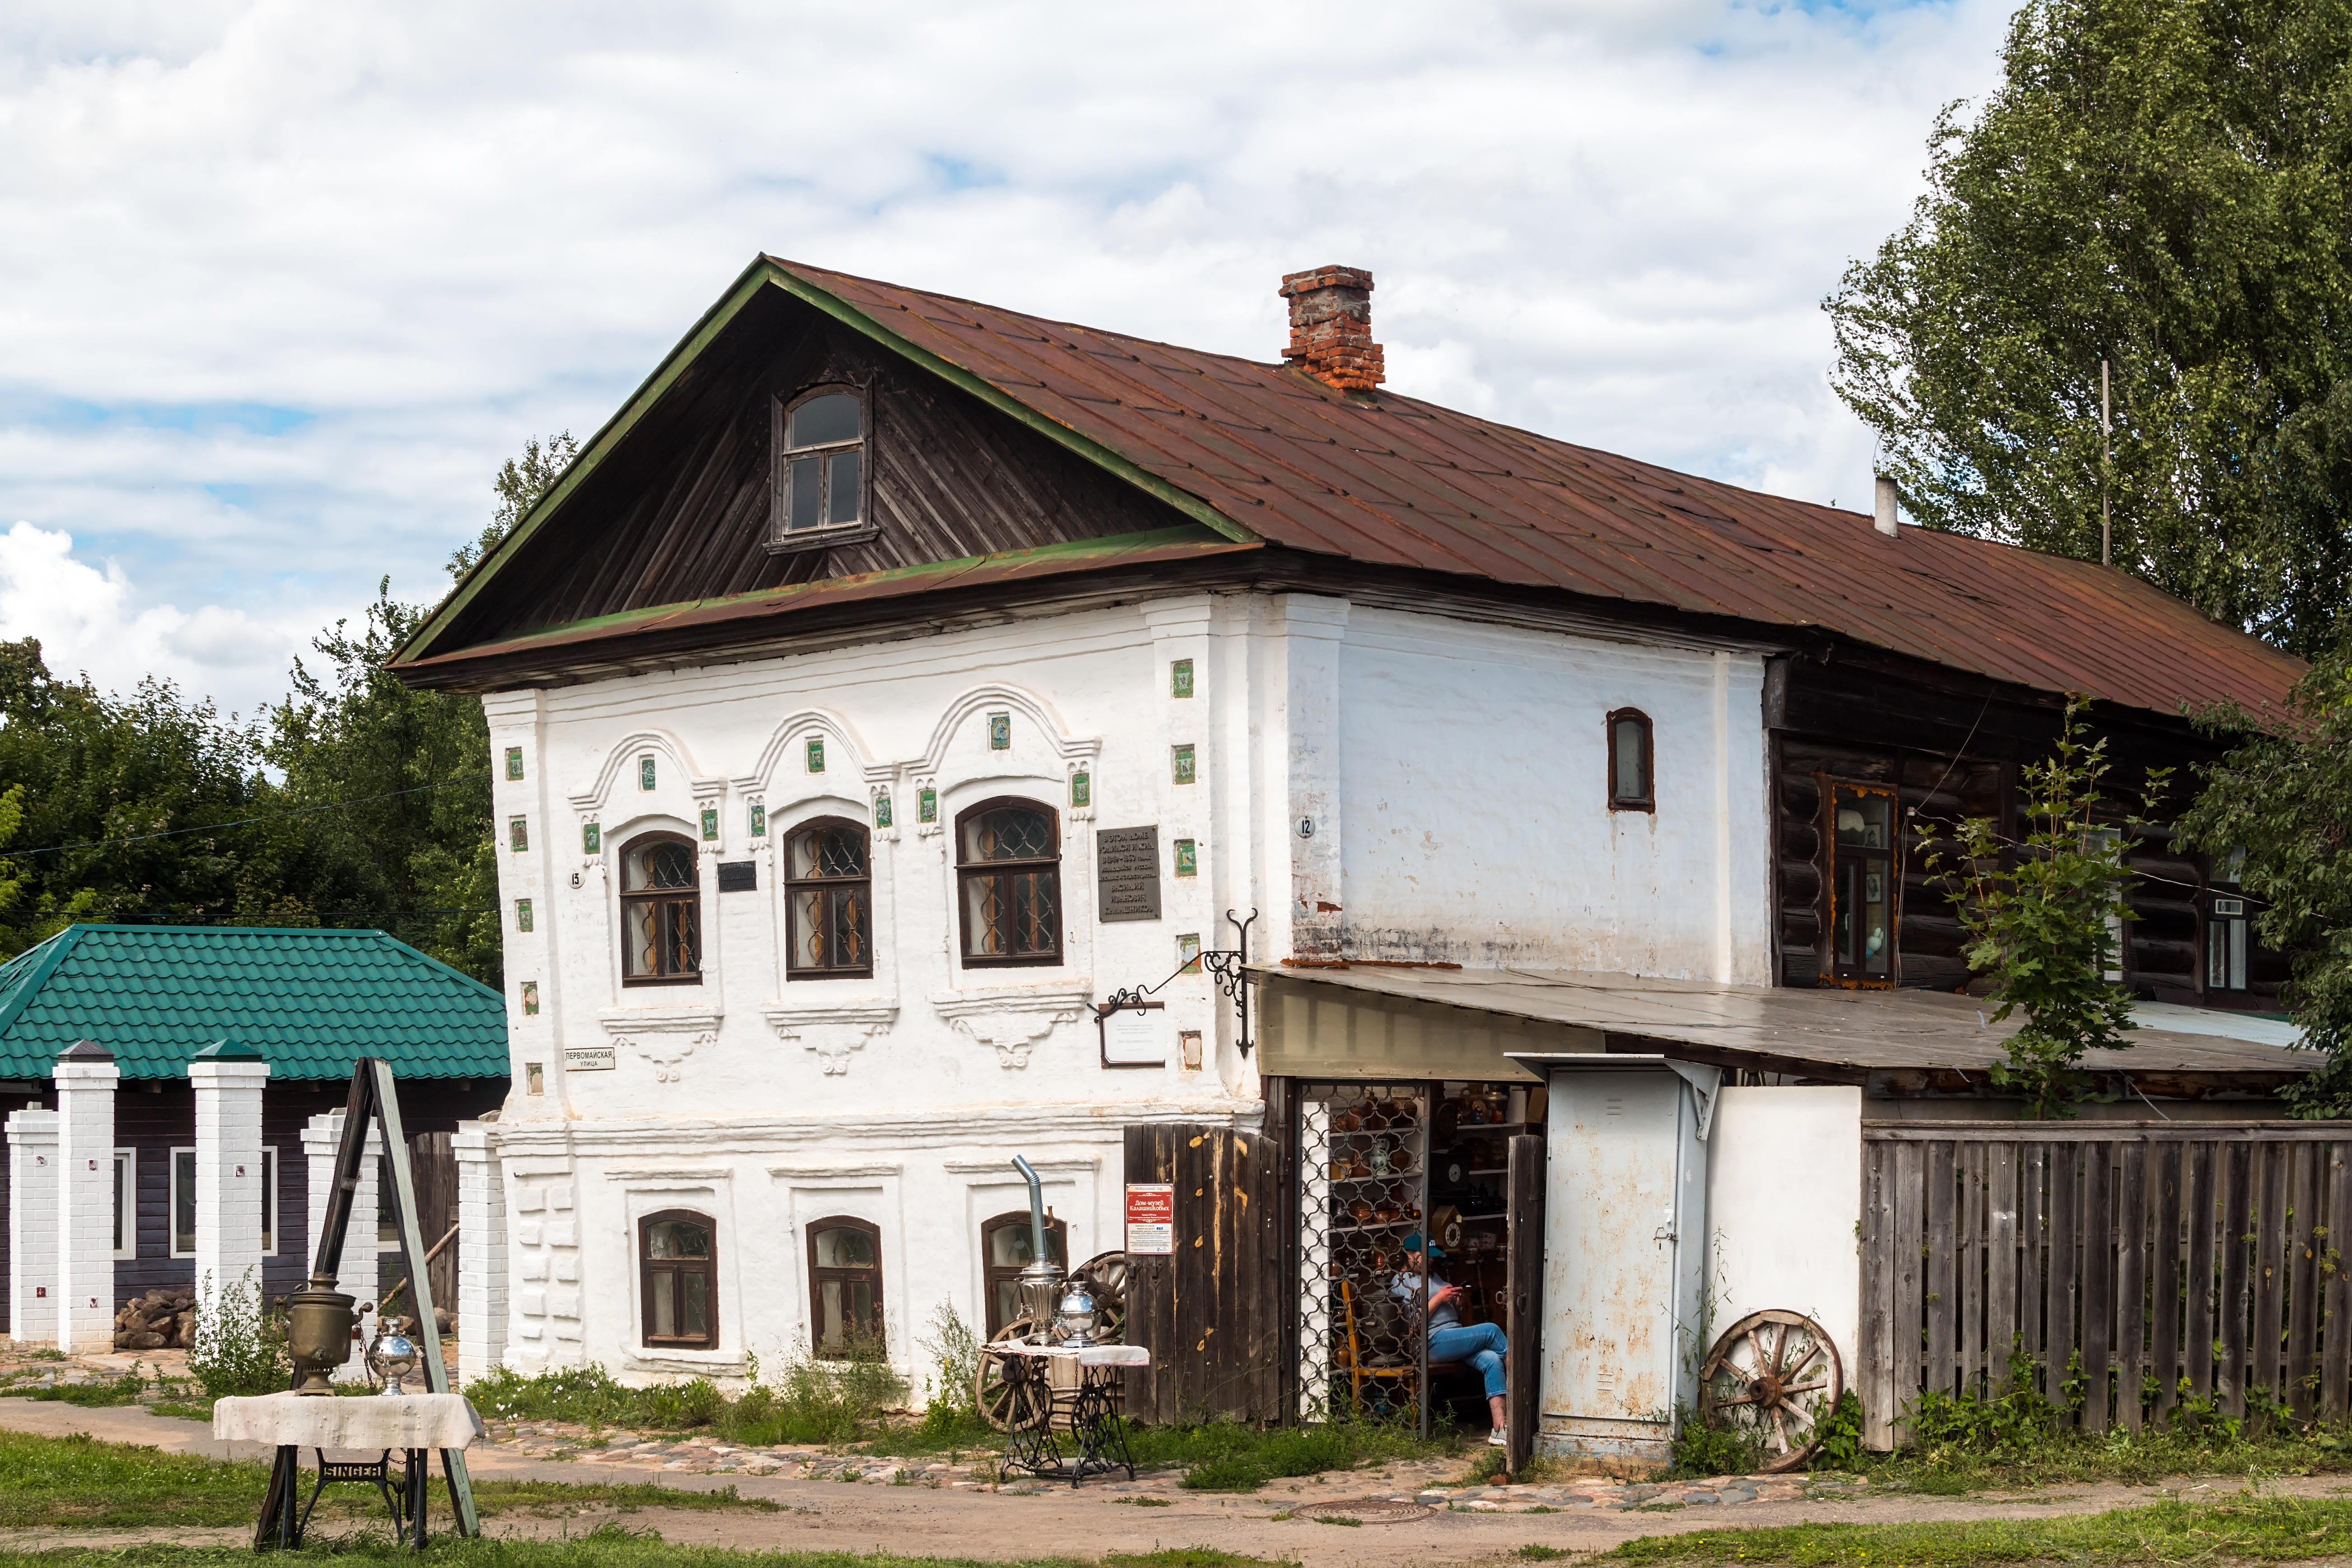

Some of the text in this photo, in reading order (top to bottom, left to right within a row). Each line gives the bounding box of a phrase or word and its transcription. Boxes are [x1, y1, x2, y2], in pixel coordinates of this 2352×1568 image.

[1302, 820, 1310, 833] 12
[1109, 833, 1127, 842] ЭТОМ
[1130, 832, 1148, 840] ДОМЕ
[1098, 844, 1130, 853] РОДИЛСЯ
[572, 873, 579, 885] 13
[1111, 882, 1145, 892] ВАСИЛИЙ
[1111, 894, 1147, 903] ИВАНОВИЧ
[1104, 905, 1153, 915] КАЛАШНИКОВ
[566, 1050, 612, 1059] ПЕРВОМАЙСКАЯ
[382, 1066, 473, 1526] АНТИКВАРАТ
[325, 1466, 379, 1477] SINGER
